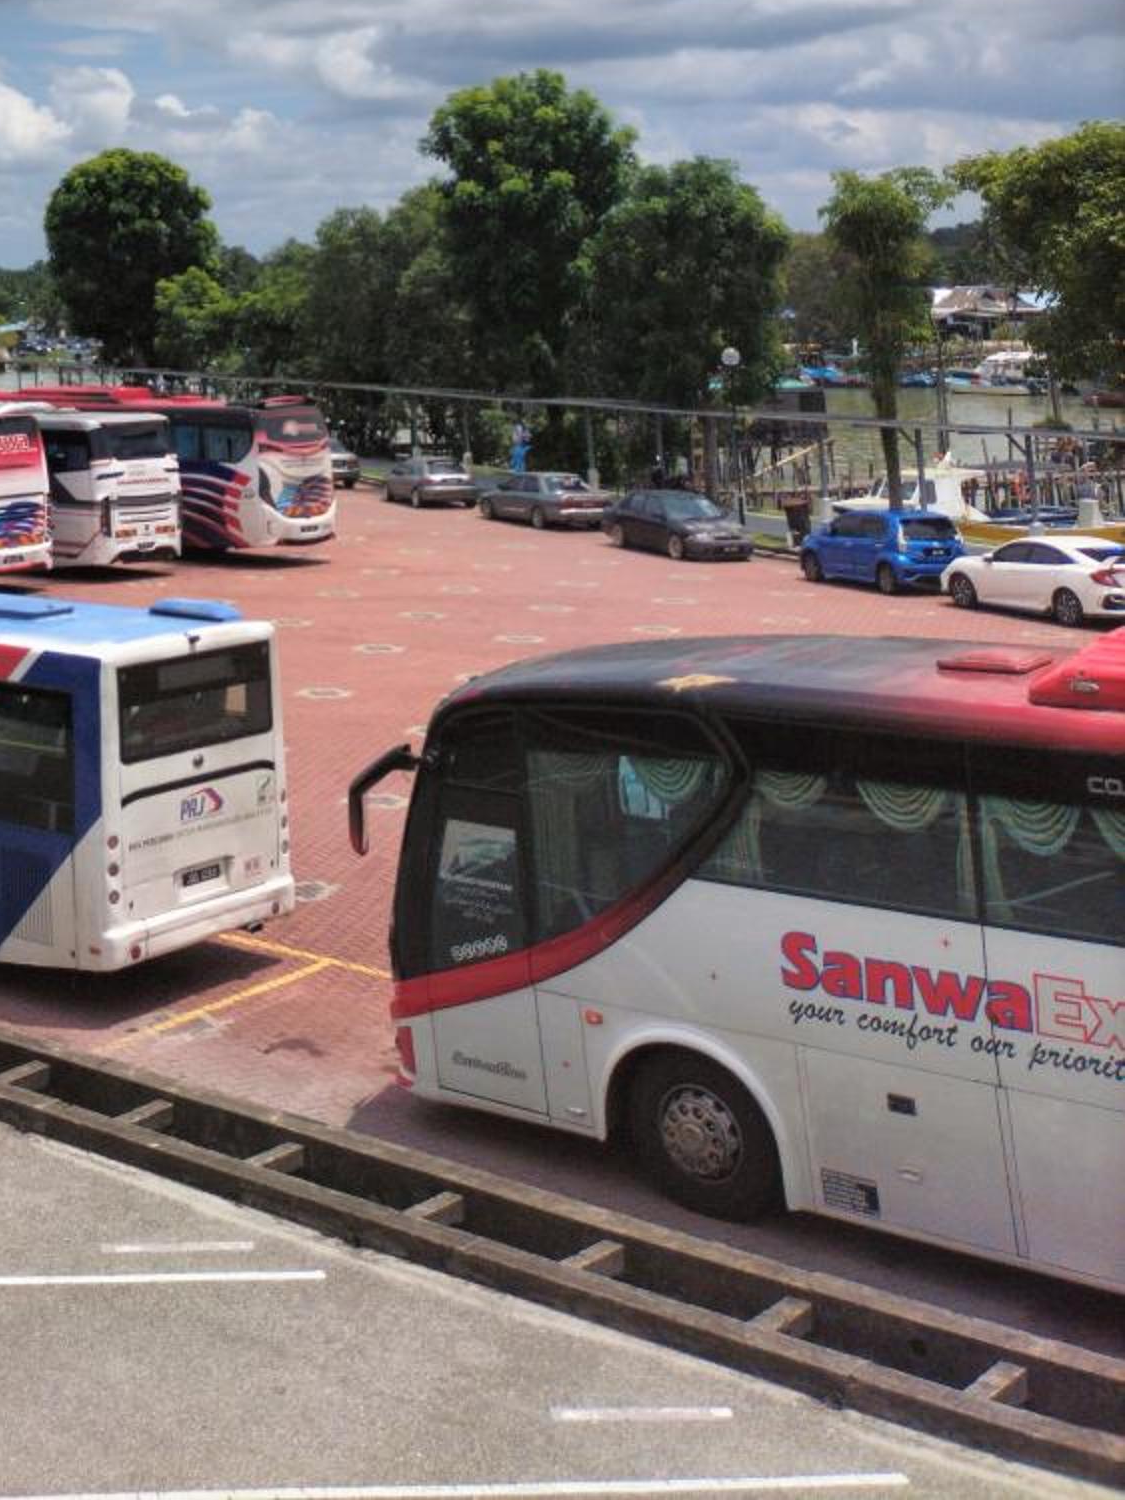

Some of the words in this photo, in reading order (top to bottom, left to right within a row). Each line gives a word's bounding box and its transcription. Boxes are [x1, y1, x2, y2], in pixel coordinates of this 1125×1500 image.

[780, 931, 1033, 1033] Sanwa
[788, 999, 846, 1025] your
[856, 1013, 959, 1050] comfort
[970, 1035, 1016, 1059] our
